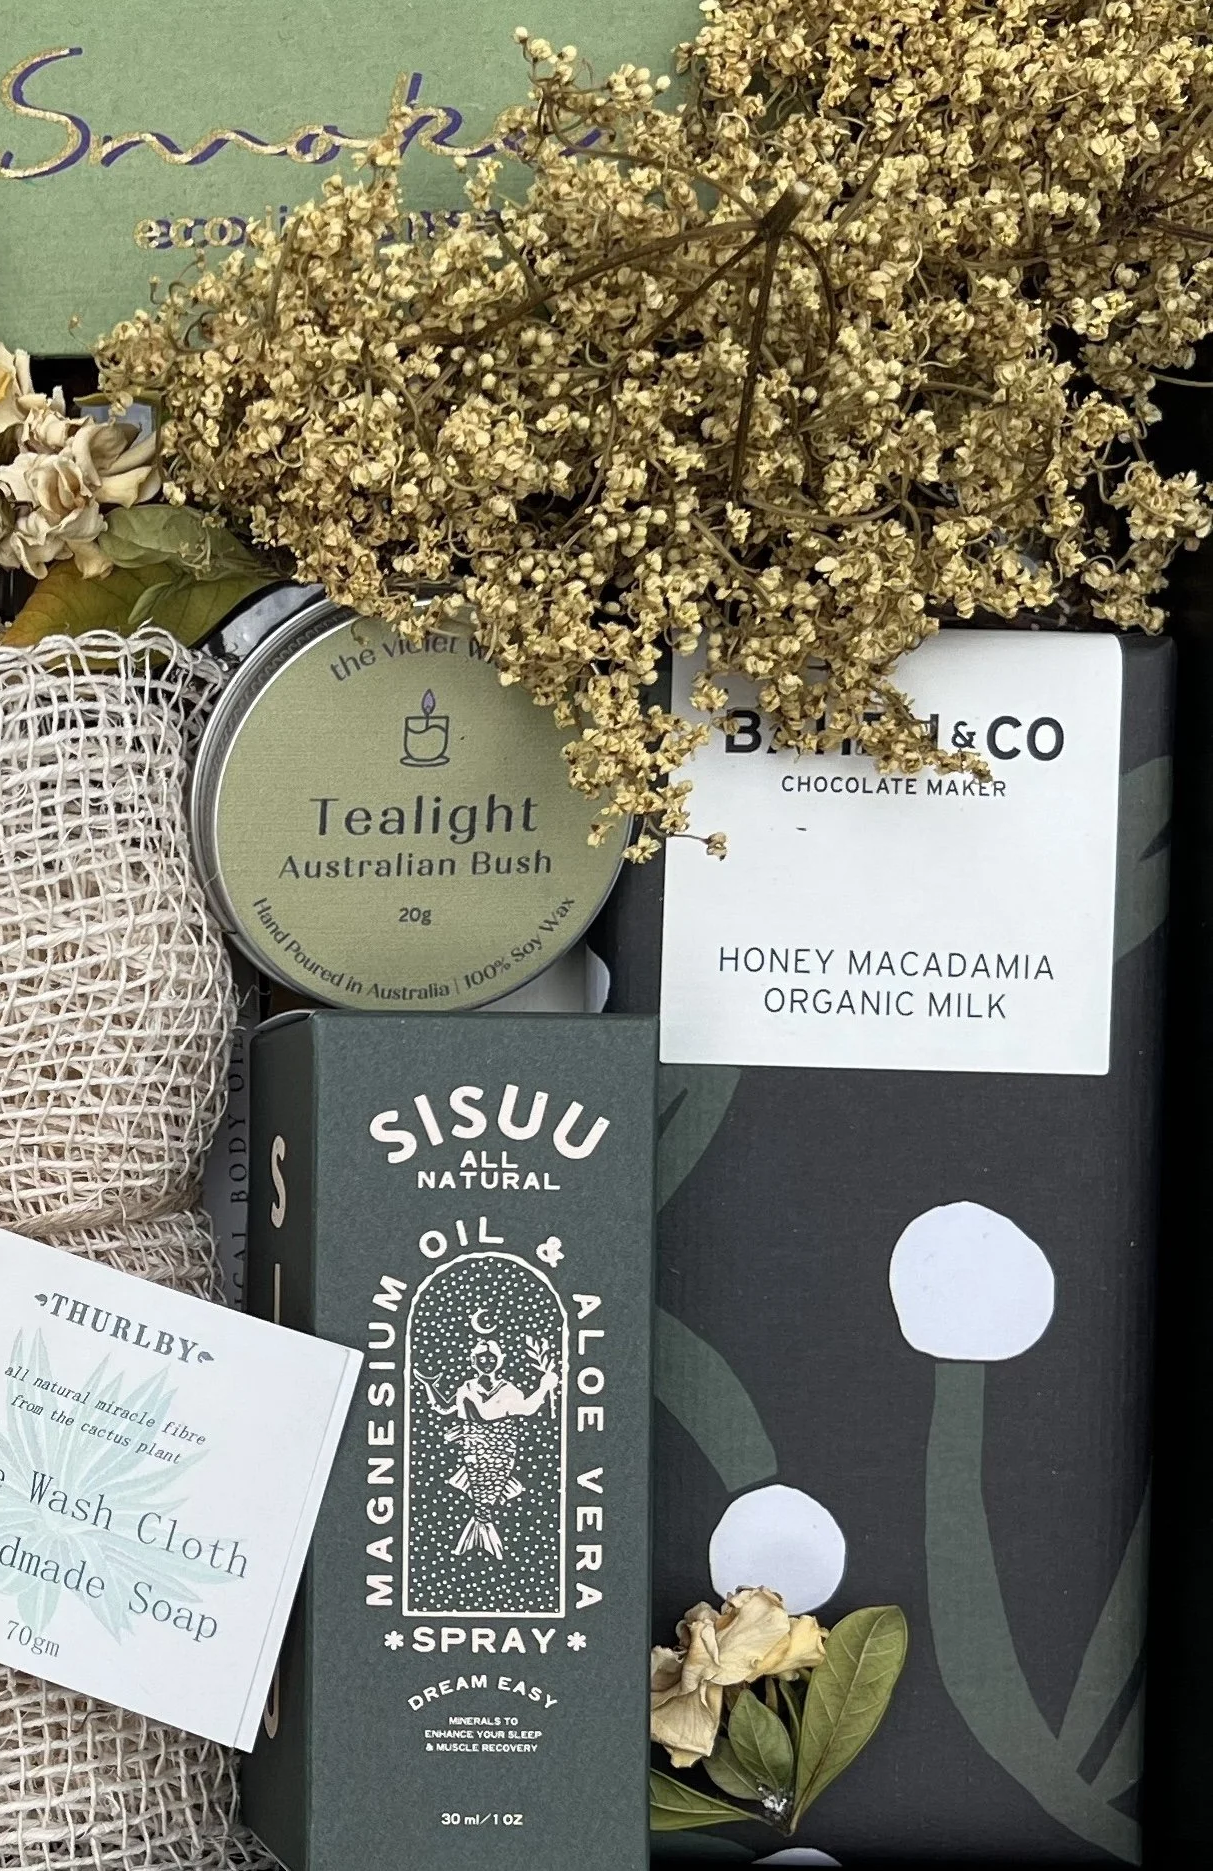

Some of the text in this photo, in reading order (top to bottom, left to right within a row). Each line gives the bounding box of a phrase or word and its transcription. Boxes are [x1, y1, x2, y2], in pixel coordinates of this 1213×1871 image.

[330, 649, 377, 681] the
[781, 775, 1006, 797] CHOCOLATE MAKER
[310, 794, 538, 844] Tealight
[278, 849, 552, 879] Australian Bush
[398, 907, 432, 926] 20g
[252, 897, 576, 1001] Hand Poured in Australia 100% Soy Wax
[719, 946, 1054, 980] HONEY MACADAMIA
[764, 987, 1006, 1019] ORGANIC MILK
[369, 1083, 610, 1164] SISUU
[460, 1150, 518, 1169] ALL
[417, 1170, 561, 1191] NATURAL
[48, 1292, 200, 1364] THURLBY
[4, 1363, 206, 1447] all natural miracle fibre
[365, 1216, 605, 1610] MAGNESIUM OIL & ALOE VERA
[10, 1394, 181, 1465] from the cactus plant
[30, 1469, 114, 1532] Wash
[137, 1510, 249, 1579] Cloth
[128, 1581, 218, 1642] Soap
[6, 1619, 61, 1658] 70gm
[412, 1626, 557, 1654] SPRAY
[407, 1674, 558, 1711] DREAM EASY
[424, 1729, 543, 1739] ENHANCE YOUR SLEEP
[448, 1716, 519, 1726] MINERALS TO
[425, 1743, 538, 1753] & MUSCLE RECOVERY
[441, 1813, 461, 1826] 30
[502, 1813, 524, 1826] OZ
